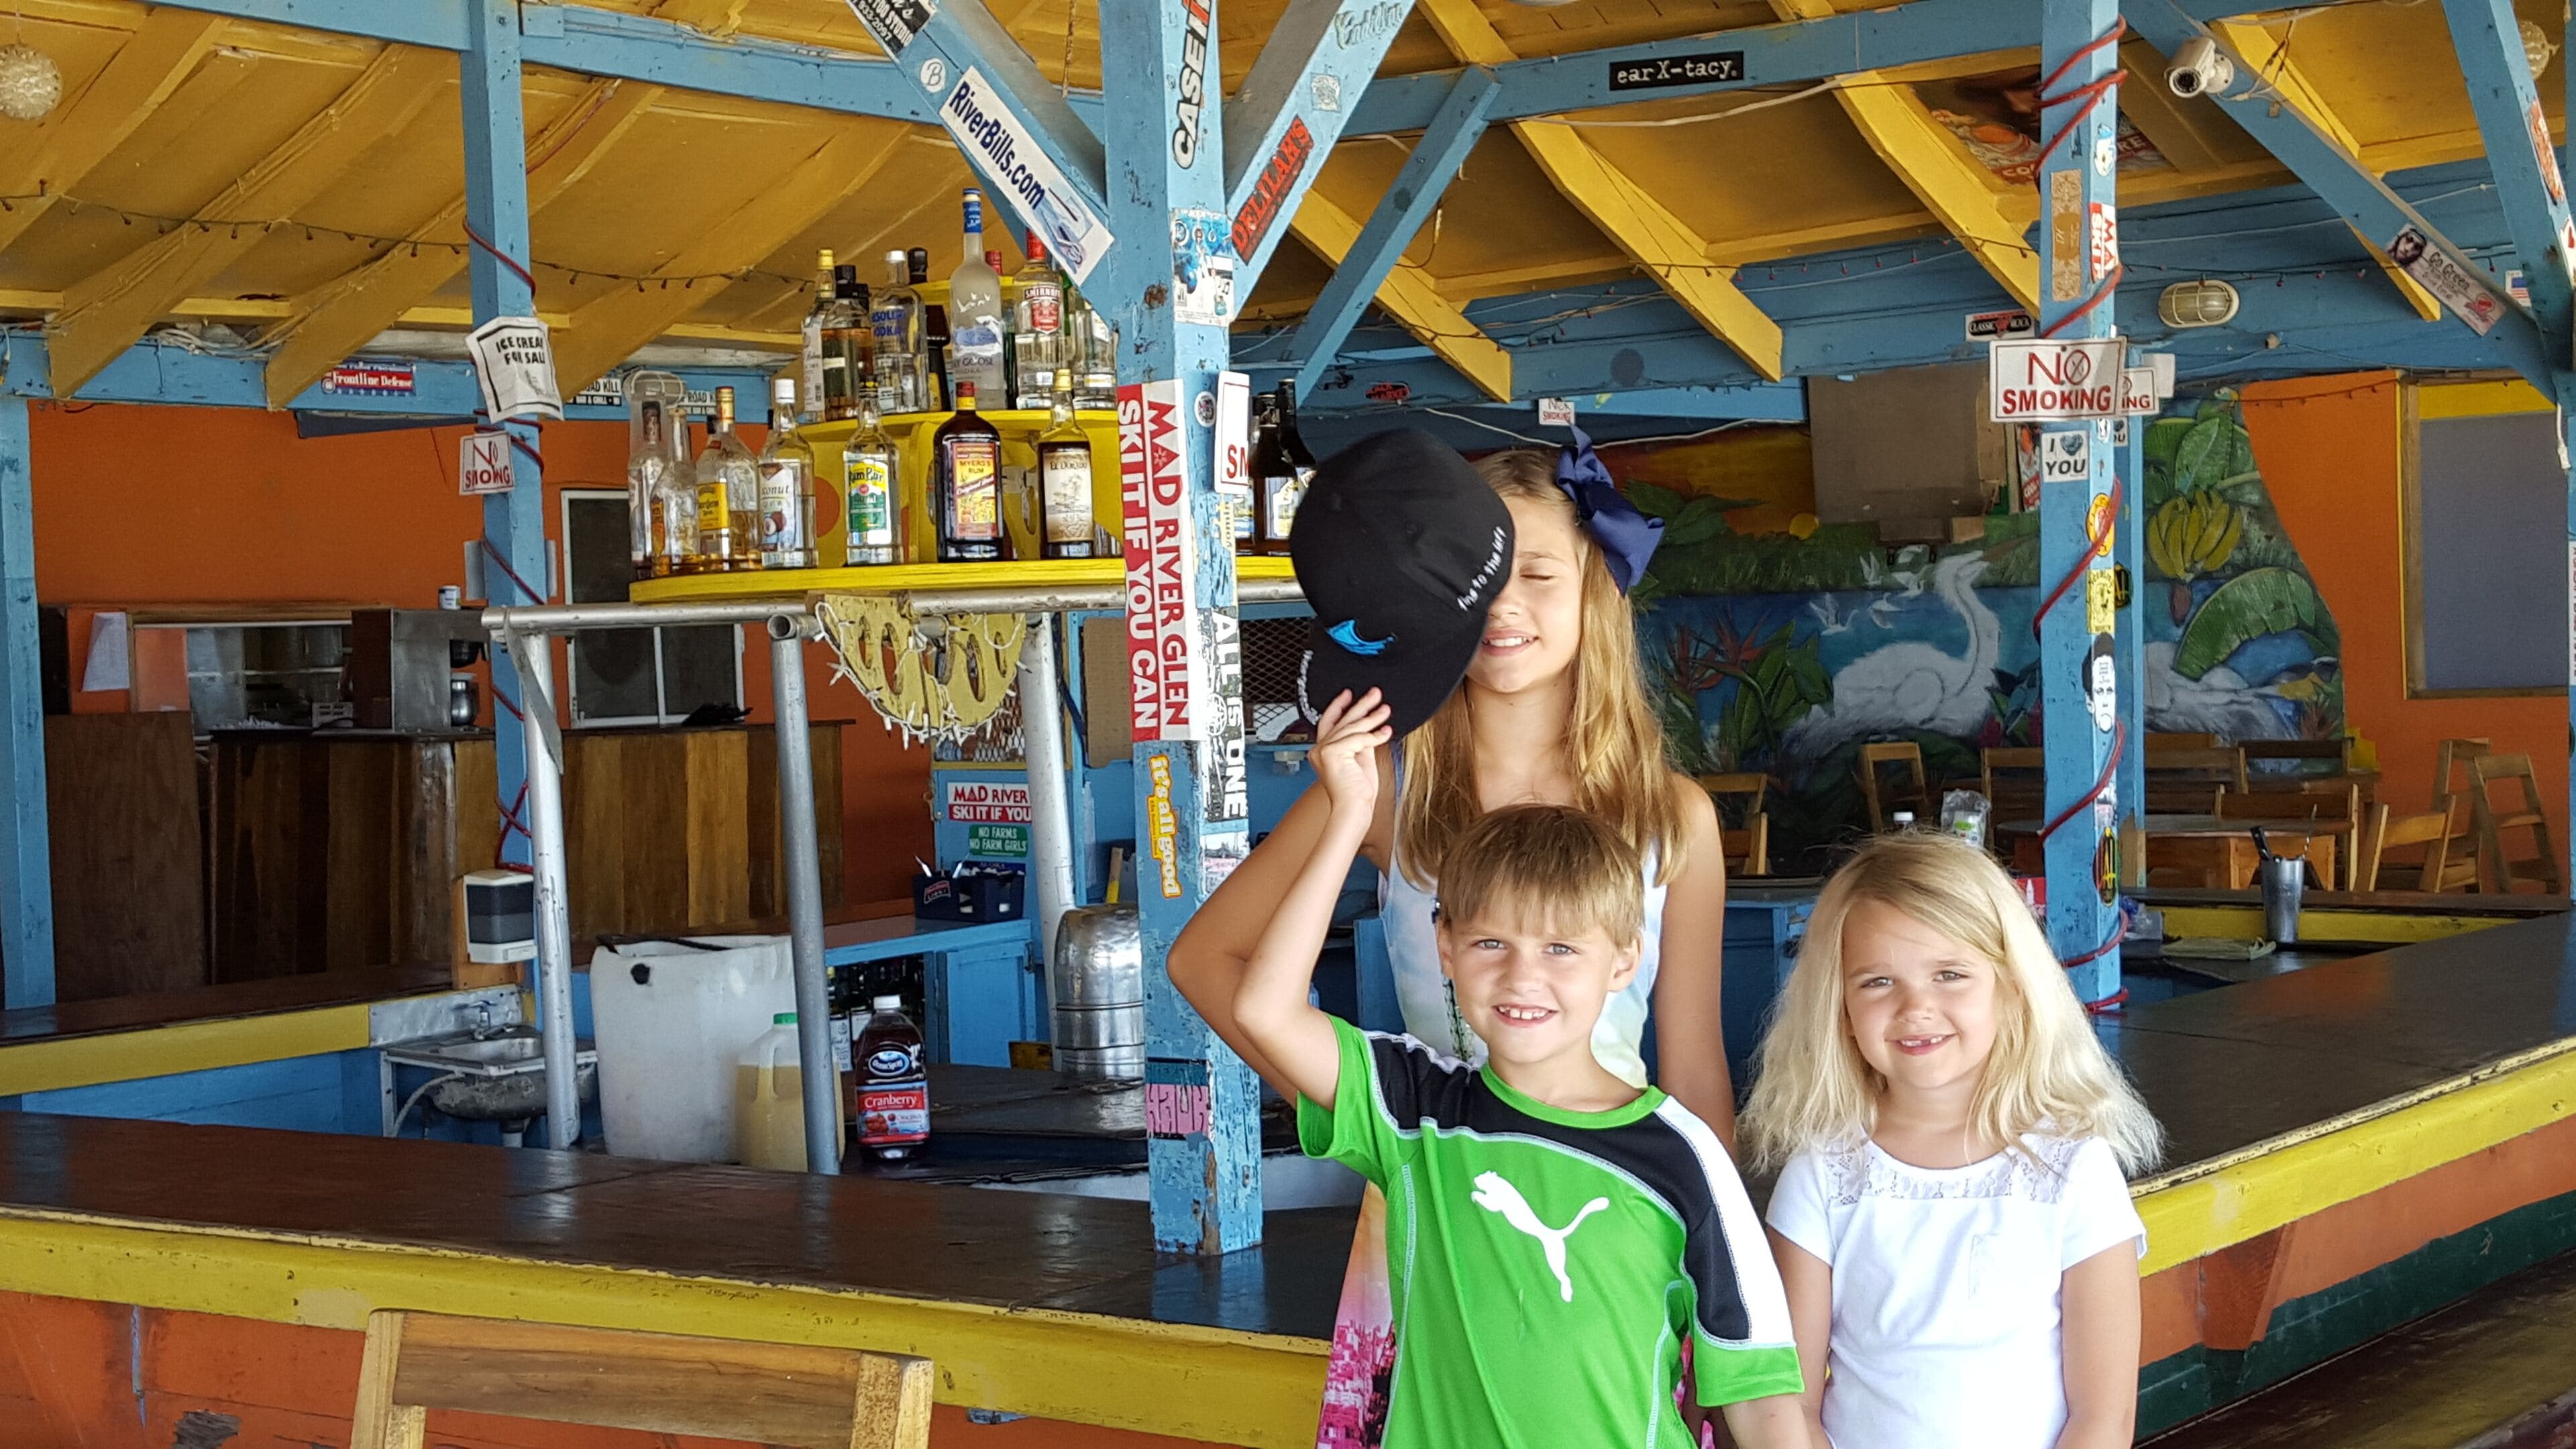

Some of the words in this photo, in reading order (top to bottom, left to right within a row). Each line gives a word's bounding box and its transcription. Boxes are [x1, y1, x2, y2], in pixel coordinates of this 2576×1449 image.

[857, 1, 893, 42] 933-2097
[885, 11, 914, 48] STUDIO
[1172, 37, 1208, 169] CASE
[949, 80, 1046, 211] RiverBills.com
[2104, 218, 2115, 268] MA
[496, 337, 515, 354] ICE
[874, 325, 902, 336] ODKA
[504, 352, 523, 365] FOR
[2027, 349, 2091, 386] NO
[332, 370, 379, 386] Frontline
[380, 375, 413, 387] Defense
[603, 380, 620, 392] KILL
[2001, 385, 2112, 415] SMOKING
[1118, 400, 1144, 463] SKI
[2048, 438, 2055, 453] I
[1146, 399, 1183, 506] MAD
[2045, 459, 2086, 476] YOU
[1121, 472, 1146, 508] IT
[1124, 517, 1148, 550] IF
[1155, 517, 1185, 628] RIVER
[1471, 573, 1487, 590] to
[1483, 552, 1503, 576] the
[1127, 559, 1154, 640] YOU
[1212, 611, 1242, 686] ALL
[1131, 649, 1157, 729] CAN
[1161, 633, 1189, 725] GLEN
[1227, 697, 1243, 727] IS
[953, 786, 988, 802] MAD
[992, 790, 1028, 804] RIVER
[1223, 739, 1248, 819] ONE
[953, 805, 973, 820] SKI
[976, 806, 989, 820] IT
[991, 806, 1003, 820] IF
[1006, 807, 1032, 821] YOU
[1157, 802, 1175, 833] all
[969, 838, 981, 850] NO
[982, 839, 1004, 851] FARM
[1004, 840, 1027, 851] GIRLS
[978, 826, 989, 838] NO
[991, 826, 1018, 839] FARMS
[1158, 836, 1182, 896] good
[864, 1092, 917, 1109] Cranberry
